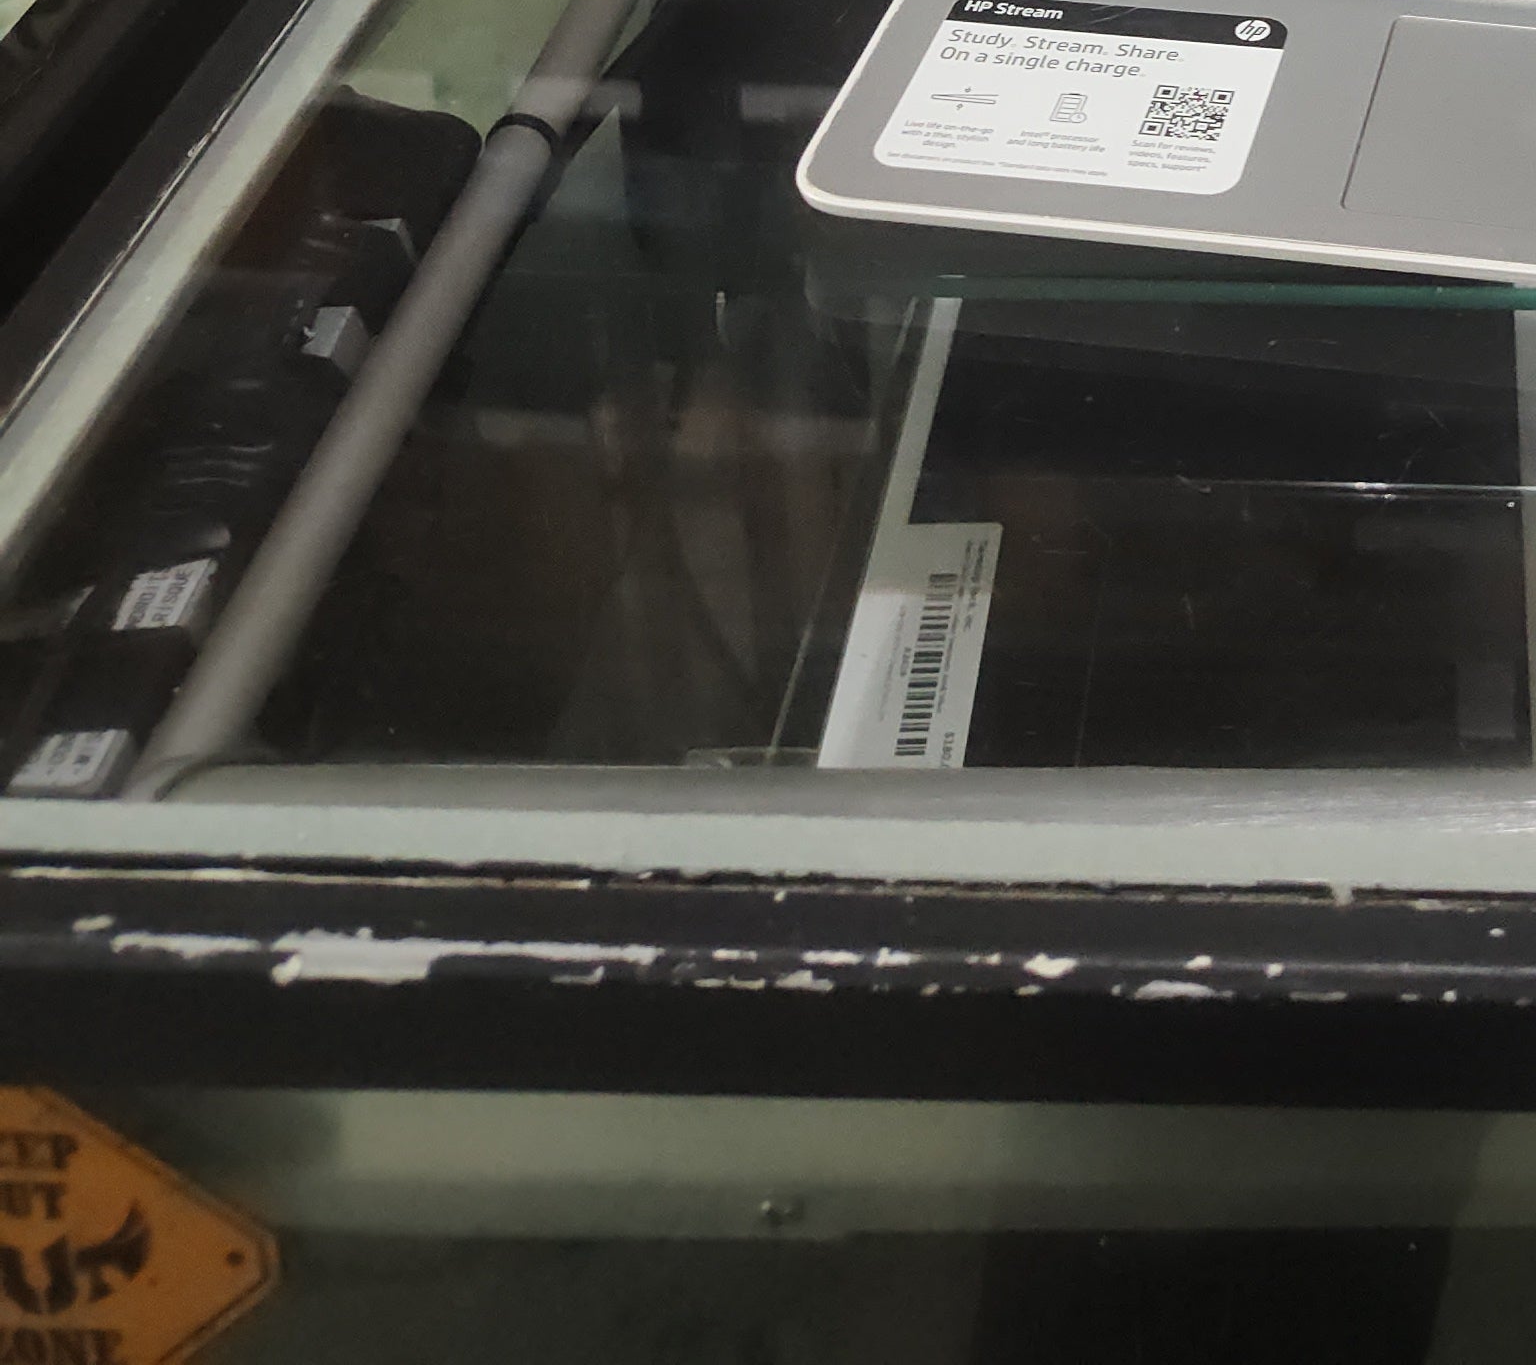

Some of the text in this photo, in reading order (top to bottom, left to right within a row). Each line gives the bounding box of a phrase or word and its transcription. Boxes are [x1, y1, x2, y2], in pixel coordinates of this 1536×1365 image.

[964, 0, 1064, 20] HP Stream
[1235, 19, 1271, 42] hp
[949, 28, 1186, 63] Study. Stream. Share.
[939, 46, 1147, 78] On a single charge.
